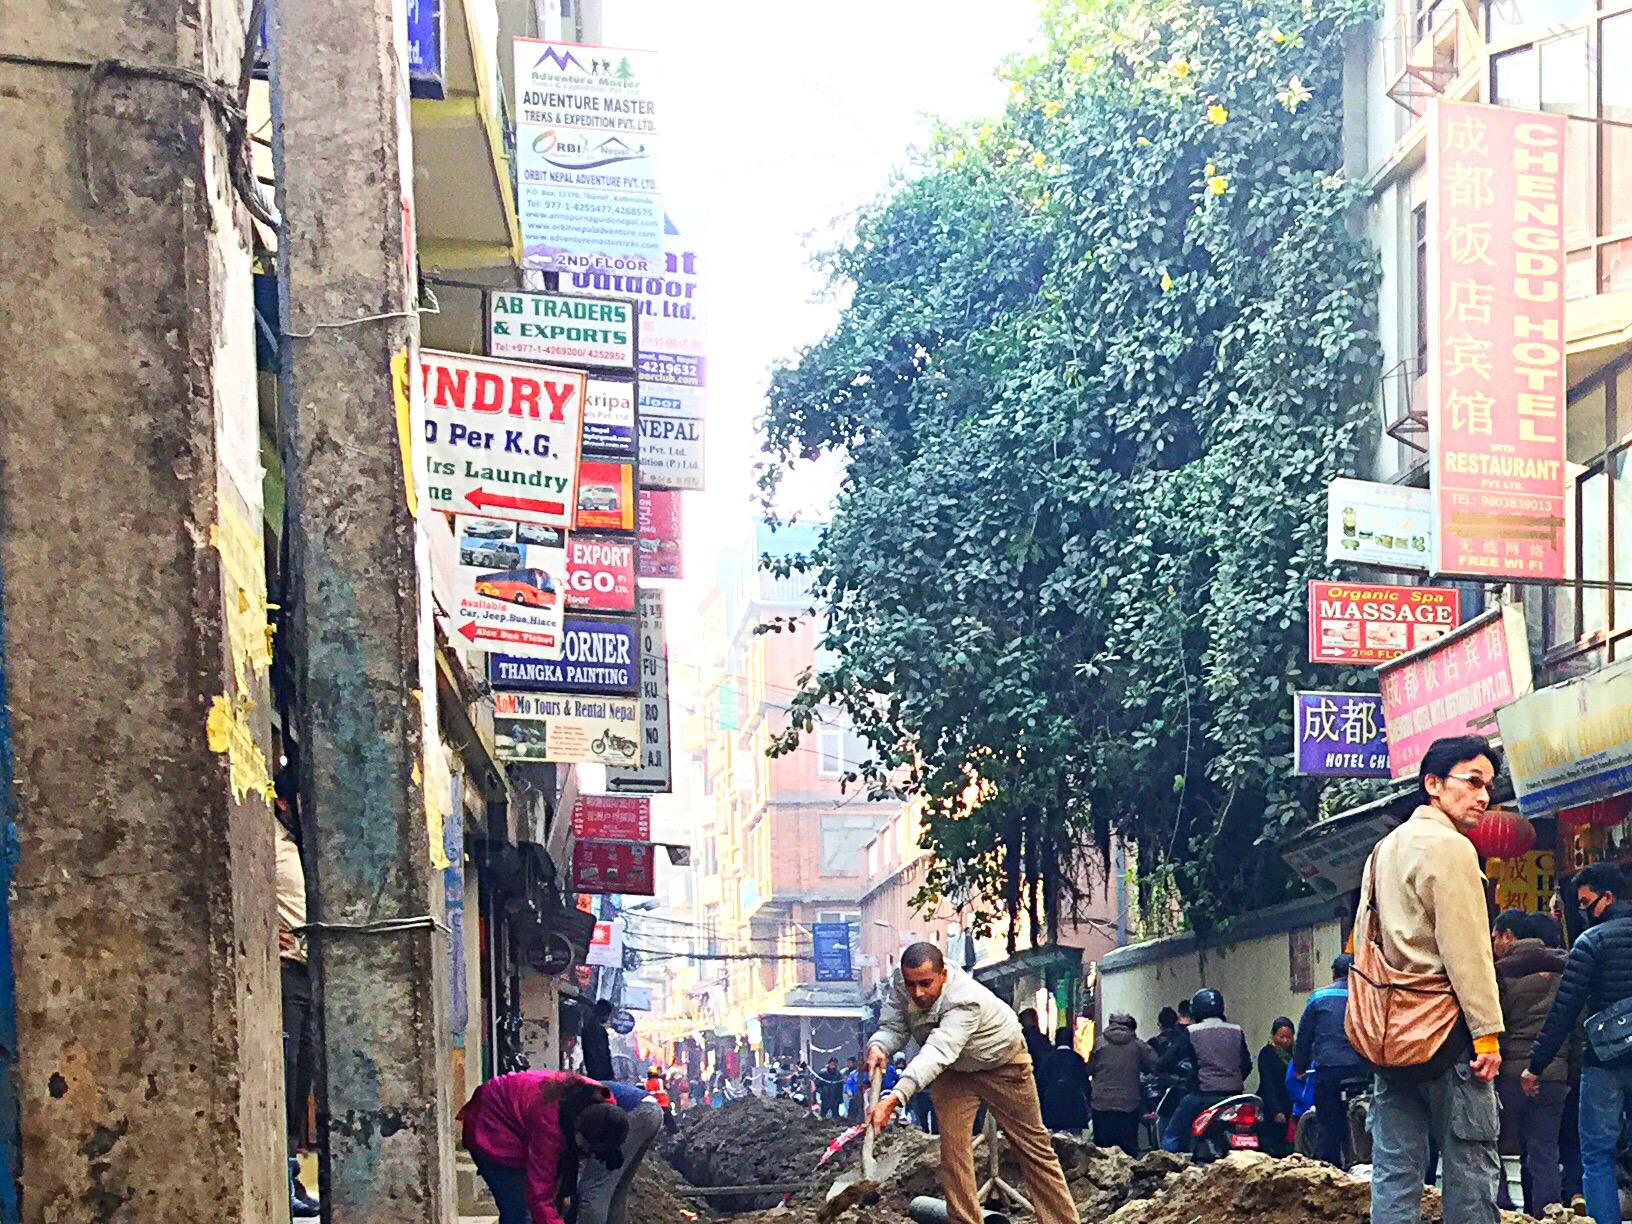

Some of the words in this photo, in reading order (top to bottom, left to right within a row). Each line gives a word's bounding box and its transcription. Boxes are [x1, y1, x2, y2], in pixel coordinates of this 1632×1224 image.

[523, 90, 600, 111] ADVENTURE
[603, 98, 656, 115] MASTER
[524, 109, 553, 123] TREKS
[564, 113, 615, 128] EXPEDITION
[524, 169, 547, 181] ORBIT
[549, 171, 574, 183] NEPAL
[575, 174, 621, 187] ADVENTURE
[1512, 122, 1561, 304] CHENGDU
[558, 255, 589, 267] 2ND
[595, 258, 648, 271] FLOOR
[1443, 114, 1497, 438] 成都饭店宾馆
[494, 296, 523, 314] AB
[531, 298, 626, 323] TRADERS
[663, 300, 696, 320] Ltd.
[493, 321, 511, 335] &
[520, 323, 627, 344] EXPORTS
[1512, 316, 1562, 444] HOTEL
[449, 423, 494, 449] Per
[504, 430, 559, 459] K.G.
[464, 461, 568, 493] Laundry
[1445, 451, 1561, 481] RESTAURANT
[1481, 480, 1502, 489] PVT.
[1504, 481, 1525, 490] LTD.
[1452, 495, 1476, 506] TEL:
[573, 544, 631, 567] EXPORT
[1458, 555, 1500, 568] FREE
[461, 598, 507, 611] Available
[1328, 587, 1400, 602] Organic
[1410, 591, 1444, 604] Spa
[460, 608, 480, 619] Car,
[1319, 600, 1453, 623] MASSAGE
[475, 628, 497, 637] Also
[500, 631, 519, 640] Bus
[560, 630, 631, 665] ORNER
[1351, 648, 1374, 658] 2nd
[499, 663, 563, 682] THANGKA
[566, 666, 628, 685] PAINTING
[534, 698, 561, 716] Tours
[563, 699, 572, 717] &
[575, 700, 606, 718] Rental
[609, 704, 636, 722] Nepal
[1303, 697, 1387, 745] 成都
[1325, 753, 1365, 769] HOTEL
